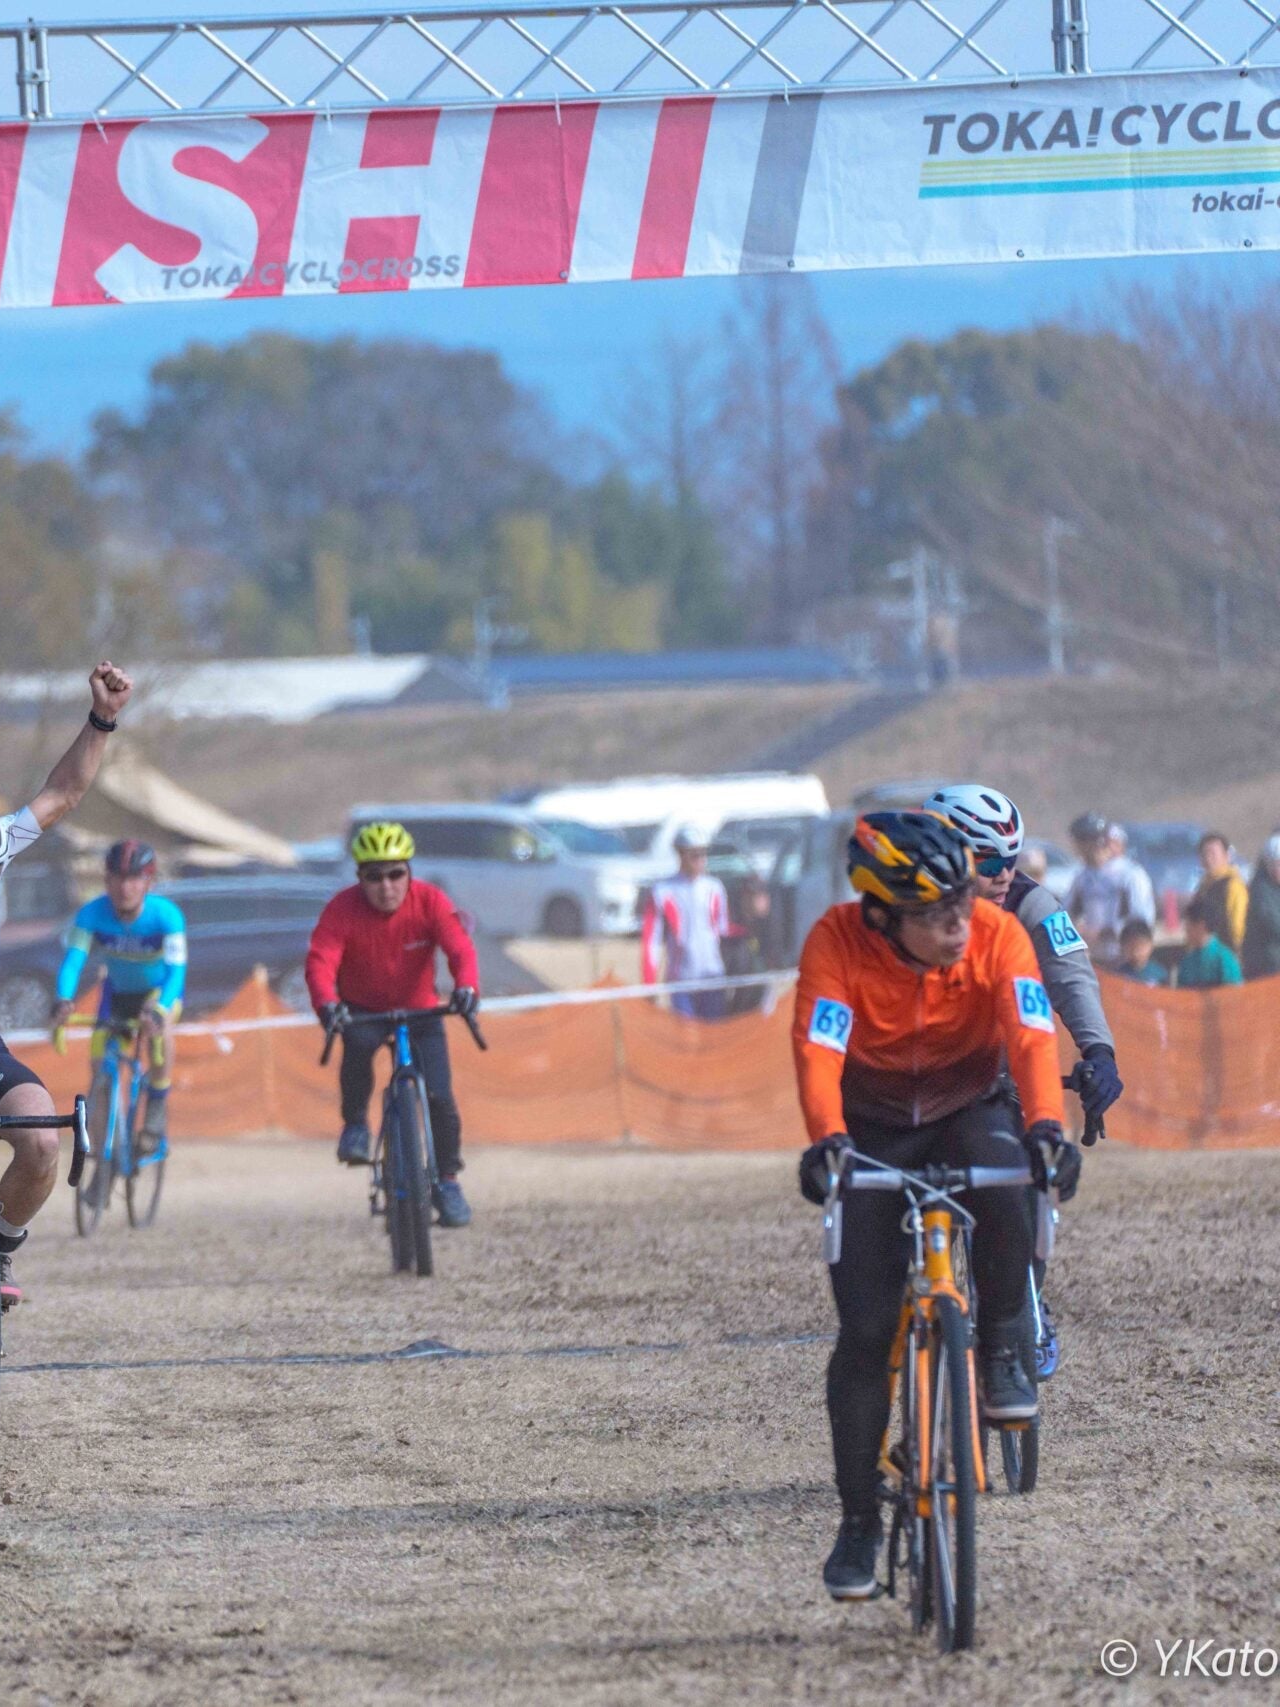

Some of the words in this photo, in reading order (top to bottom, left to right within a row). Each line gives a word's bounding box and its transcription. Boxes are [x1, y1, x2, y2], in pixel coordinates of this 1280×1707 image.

[1192, 187, 1280, 213] tokai-
[1049, 916, 1078, 945] 66
[1023, 983, 1048, 1016] 69
[816, 1004, 850, 1039] 69
